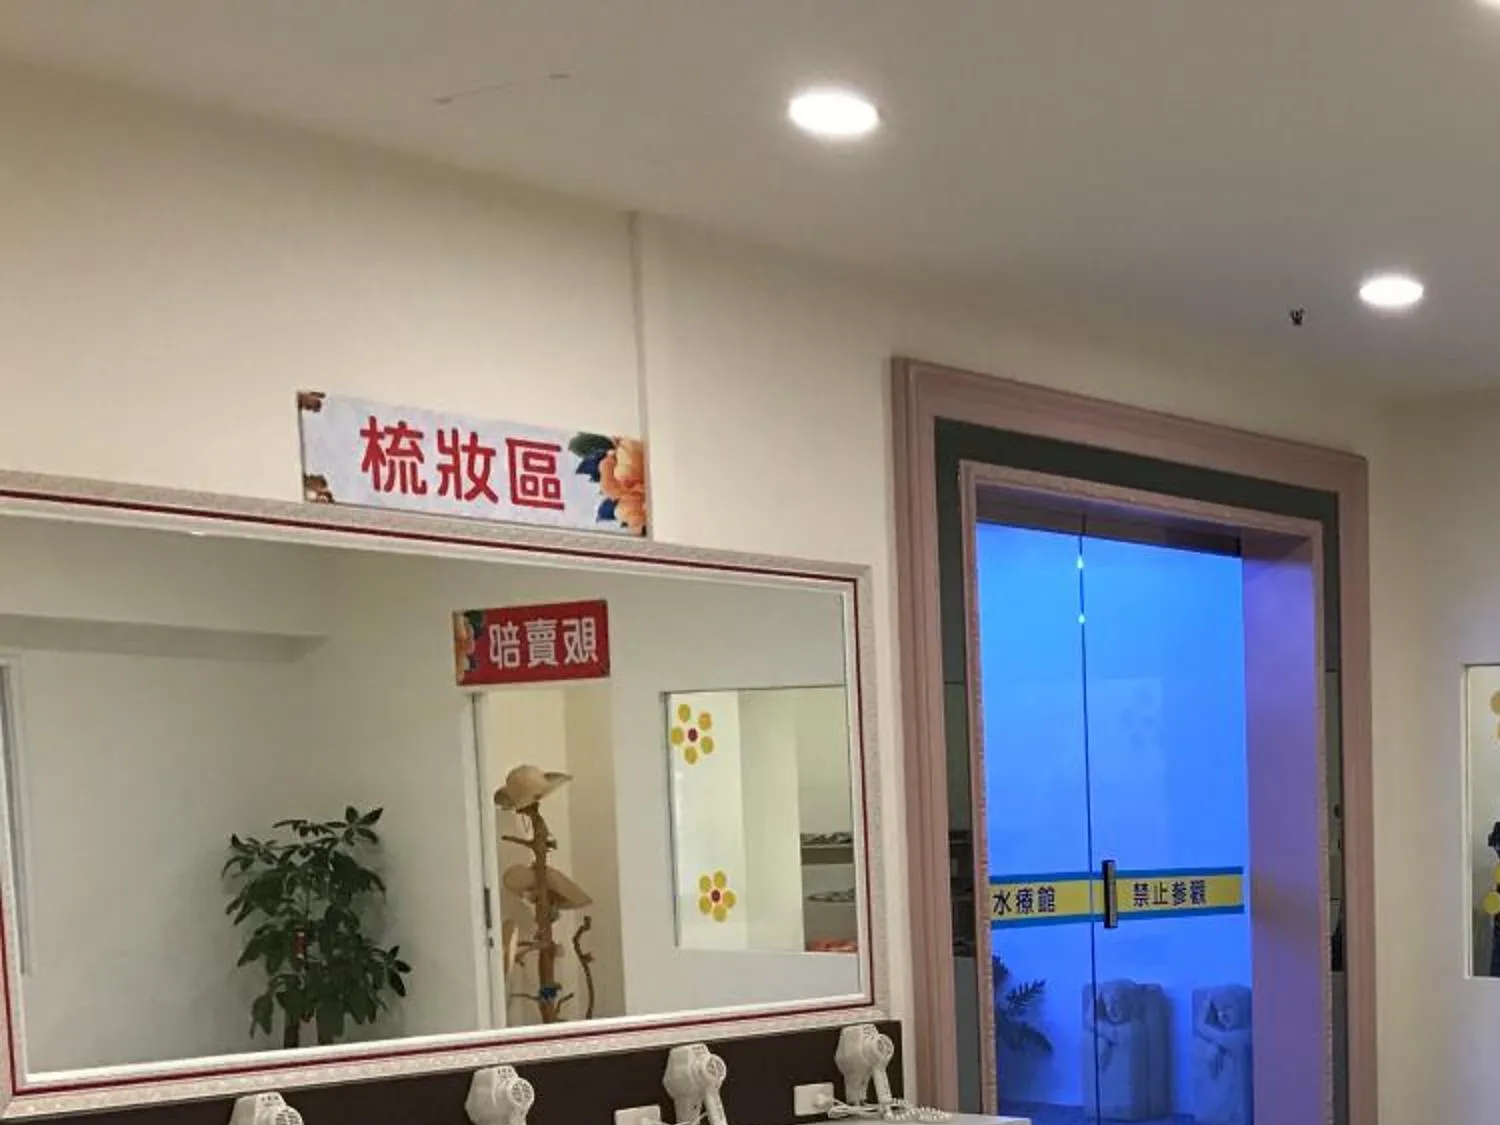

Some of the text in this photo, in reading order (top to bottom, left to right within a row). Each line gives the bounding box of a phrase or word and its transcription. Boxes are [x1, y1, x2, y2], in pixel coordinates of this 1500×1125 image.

[360, 416, 564, 510] 梳妝區
[993, 879, 1206, 915] 水療館 禁止參觀
